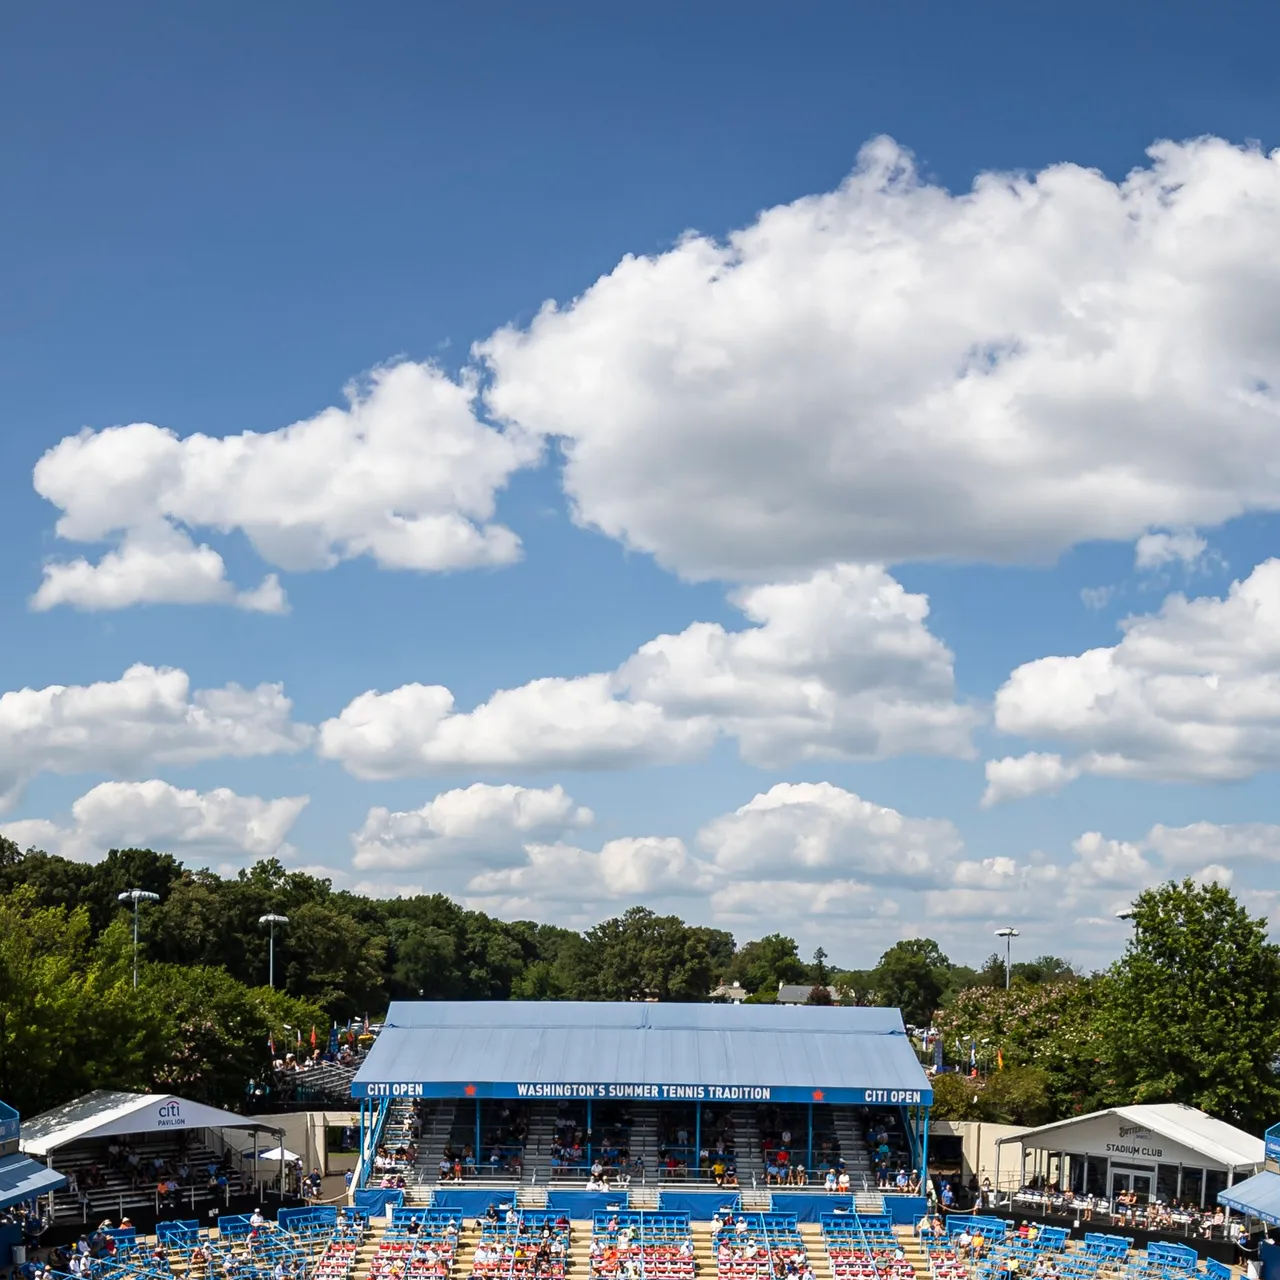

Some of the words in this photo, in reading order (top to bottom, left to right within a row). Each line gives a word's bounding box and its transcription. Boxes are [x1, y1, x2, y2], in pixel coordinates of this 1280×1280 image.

[367, 1084, 390, 1095] CITI
[393, 1084, 423, 1095] OPEN
[517, 1084, 606, 1097] WASHINGTON'S
[608, 1085, 658, 1097] SUMMER
[662, 1086, 705, 1098] TENNIS
[708, 1086, 771, 1099] TRADITION
[865, 1090, 887, 1102] CITI
[890, 1091, 921, 1103] OPEN
[158, 1103, 180, 1117] citi
[1106, 1143, 1140, 1155] STADIUM
[1141, 1148, 1163, 1157] CLUB
